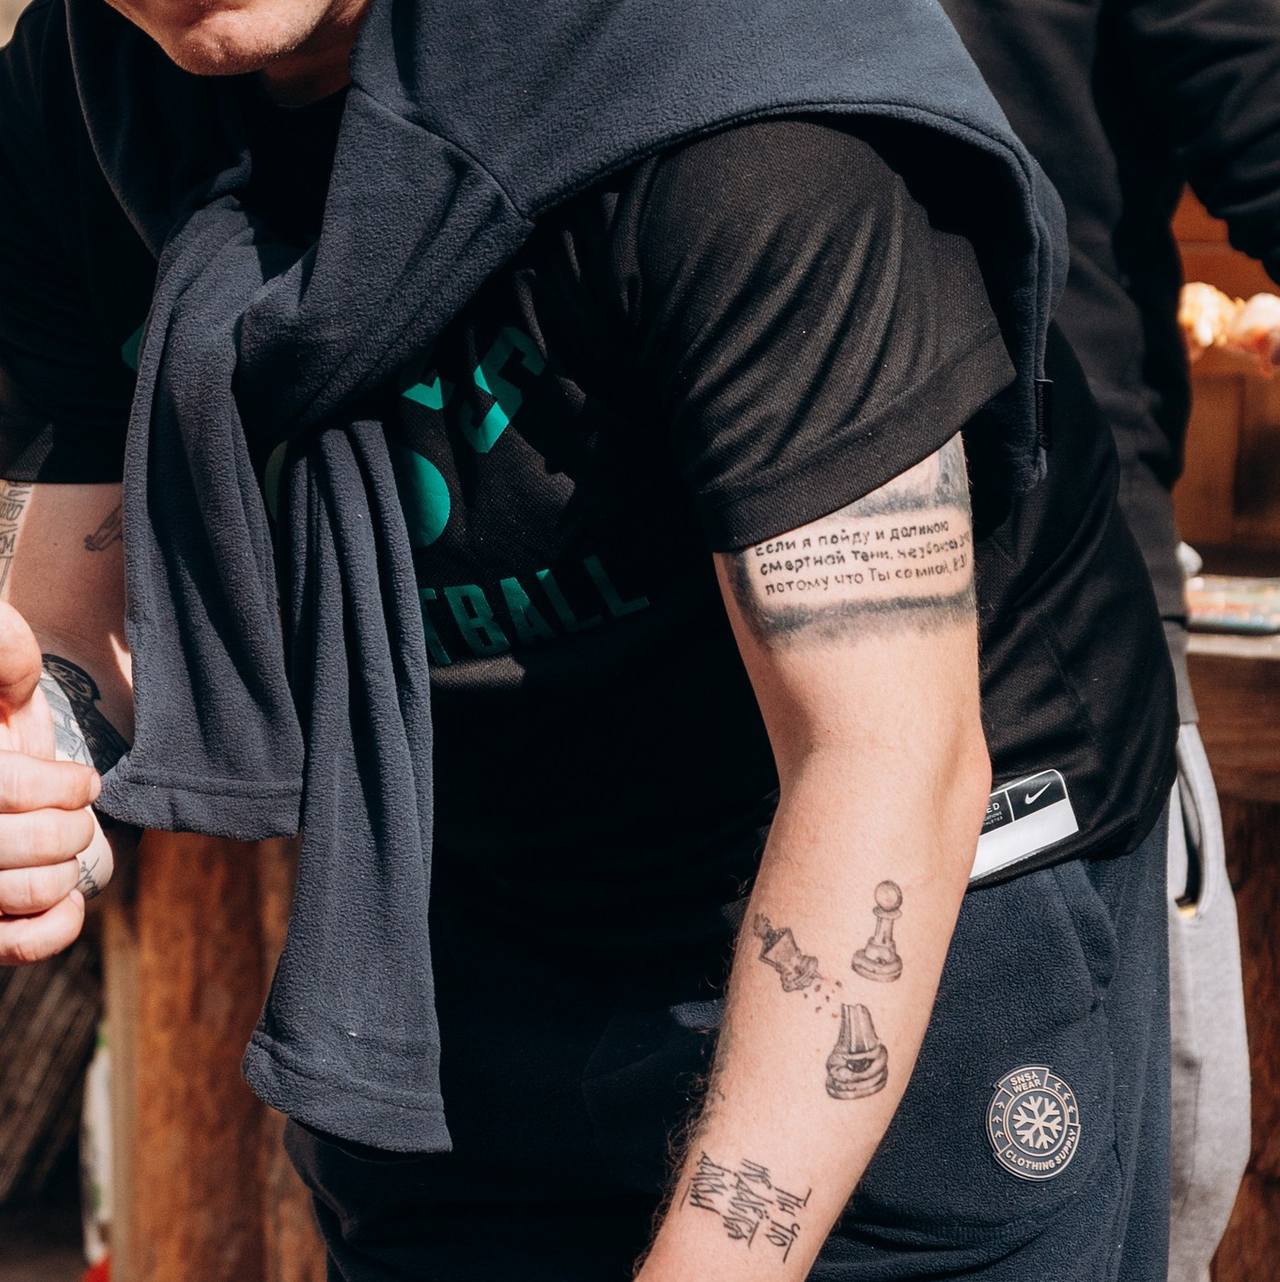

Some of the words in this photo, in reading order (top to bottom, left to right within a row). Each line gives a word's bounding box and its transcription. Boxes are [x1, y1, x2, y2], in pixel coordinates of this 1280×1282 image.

[755, 540, 796, 556] Если
[802, 538, 812, 549] я
[875, 530, 885, 540] и
[765, 575, 829, 595] потому
[834, 573, 864, 584] что
[868, 567, 890, 581] Ты
[1013, 1079, 1042, 1093] WEAR
[1005, 1149, 1055, 1171] CLOTHING
[1055, 1128, 1077, 1165] SUPPLY
